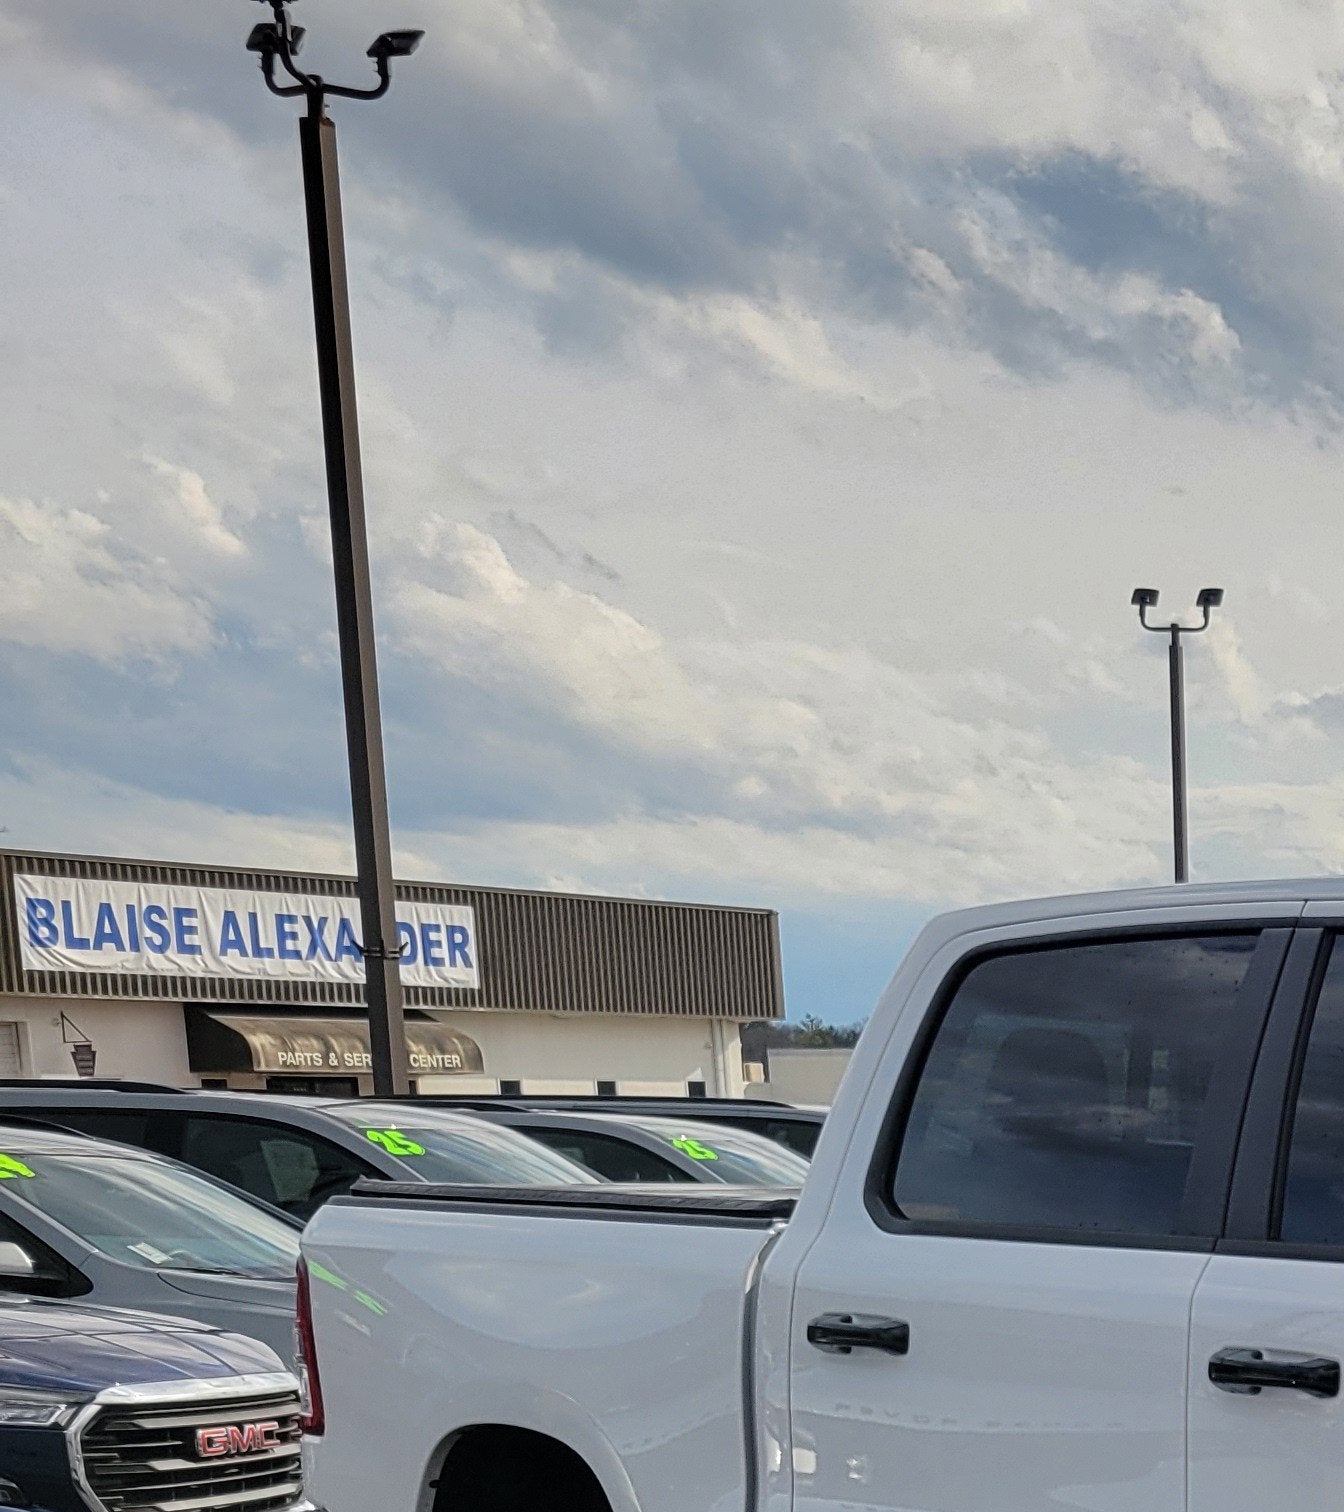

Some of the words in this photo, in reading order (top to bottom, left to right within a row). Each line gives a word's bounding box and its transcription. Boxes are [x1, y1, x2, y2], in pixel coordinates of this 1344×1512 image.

[25, 897, 201, 956] BLAISE
[219, 910, 474, 968] ALEXADER
[278, 1051, 323, 1067] PARTS
[328, 1053, 339, 1066] &
[409, 1053, 462, 1068] CENTER
[366, 1130, 426, 1156] 25
[196, 1421, 281, 1457] GMC
